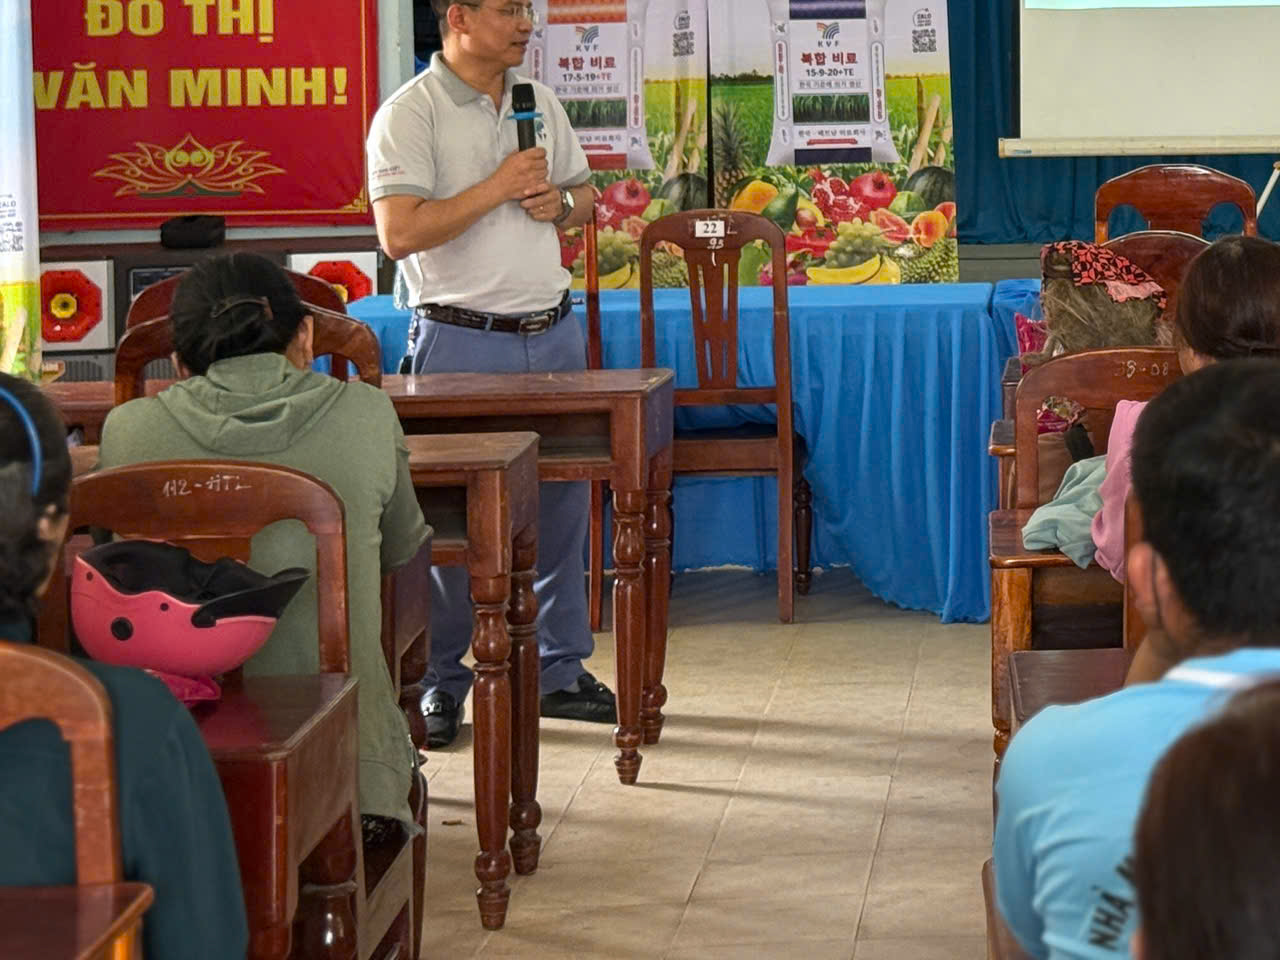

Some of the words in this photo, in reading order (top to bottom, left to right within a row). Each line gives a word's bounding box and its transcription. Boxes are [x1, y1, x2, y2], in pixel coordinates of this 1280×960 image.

[34, 62, 148, 109] VĂN
[170, 66, 348, 107] MINH!
[703, 223, 717, 234] 22
